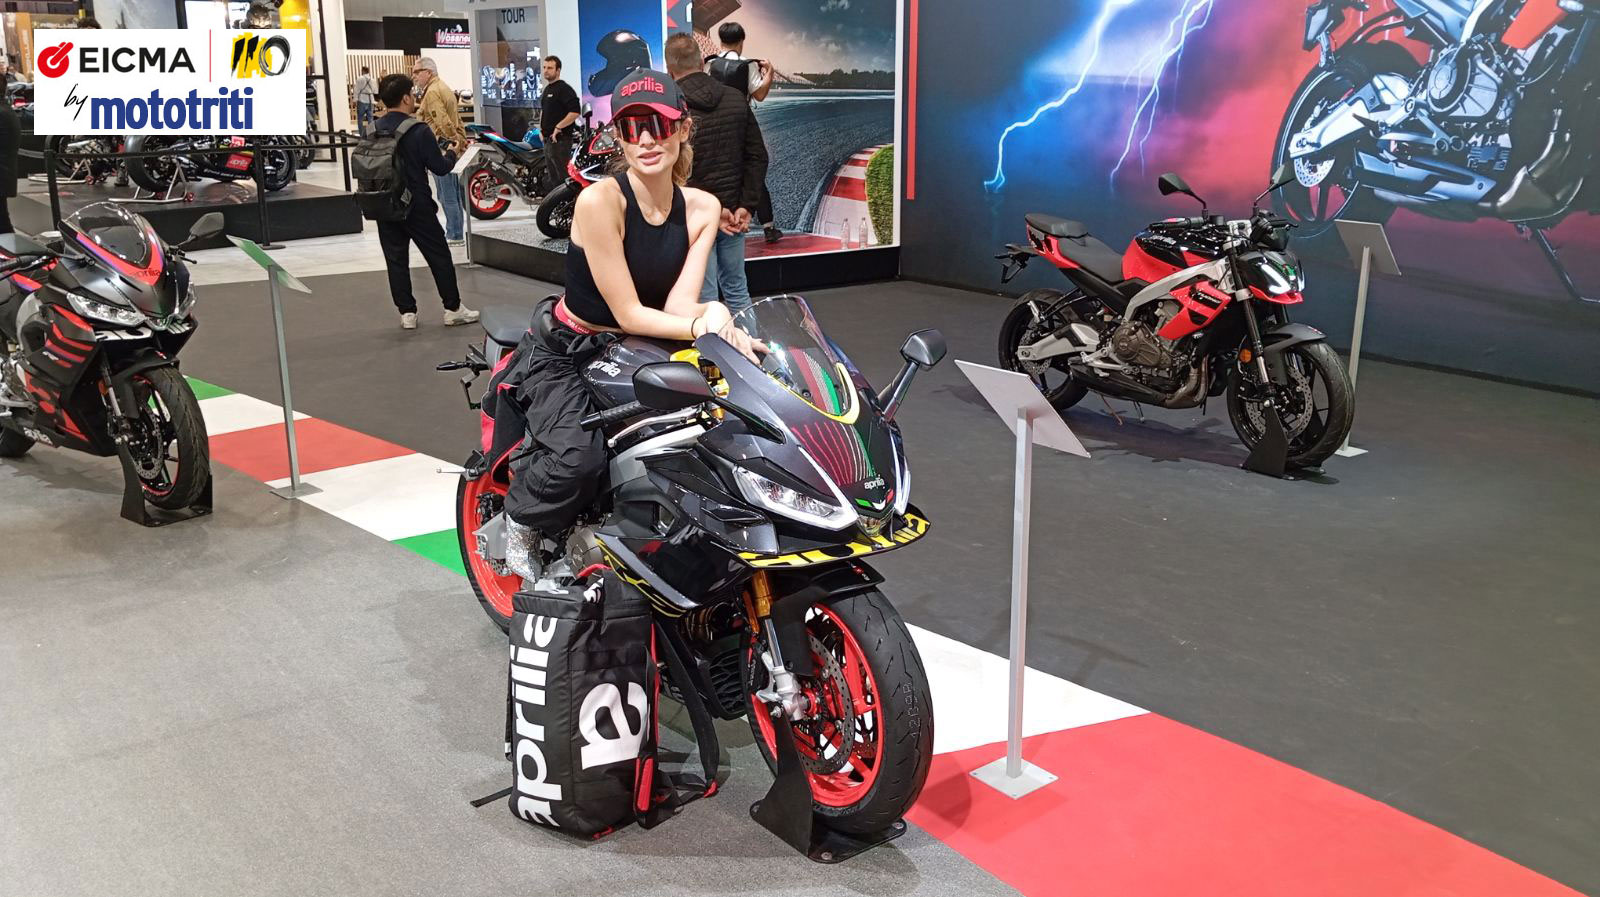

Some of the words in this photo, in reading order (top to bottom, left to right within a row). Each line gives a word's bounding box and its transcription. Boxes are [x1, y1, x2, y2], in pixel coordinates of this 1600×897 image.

[501, 8, 525, 24] TOUR
[620, 76, 664, 97] aprilia
[864, 477, 885, 490] aprilia
[510, 613, 562, 827] aprilia
